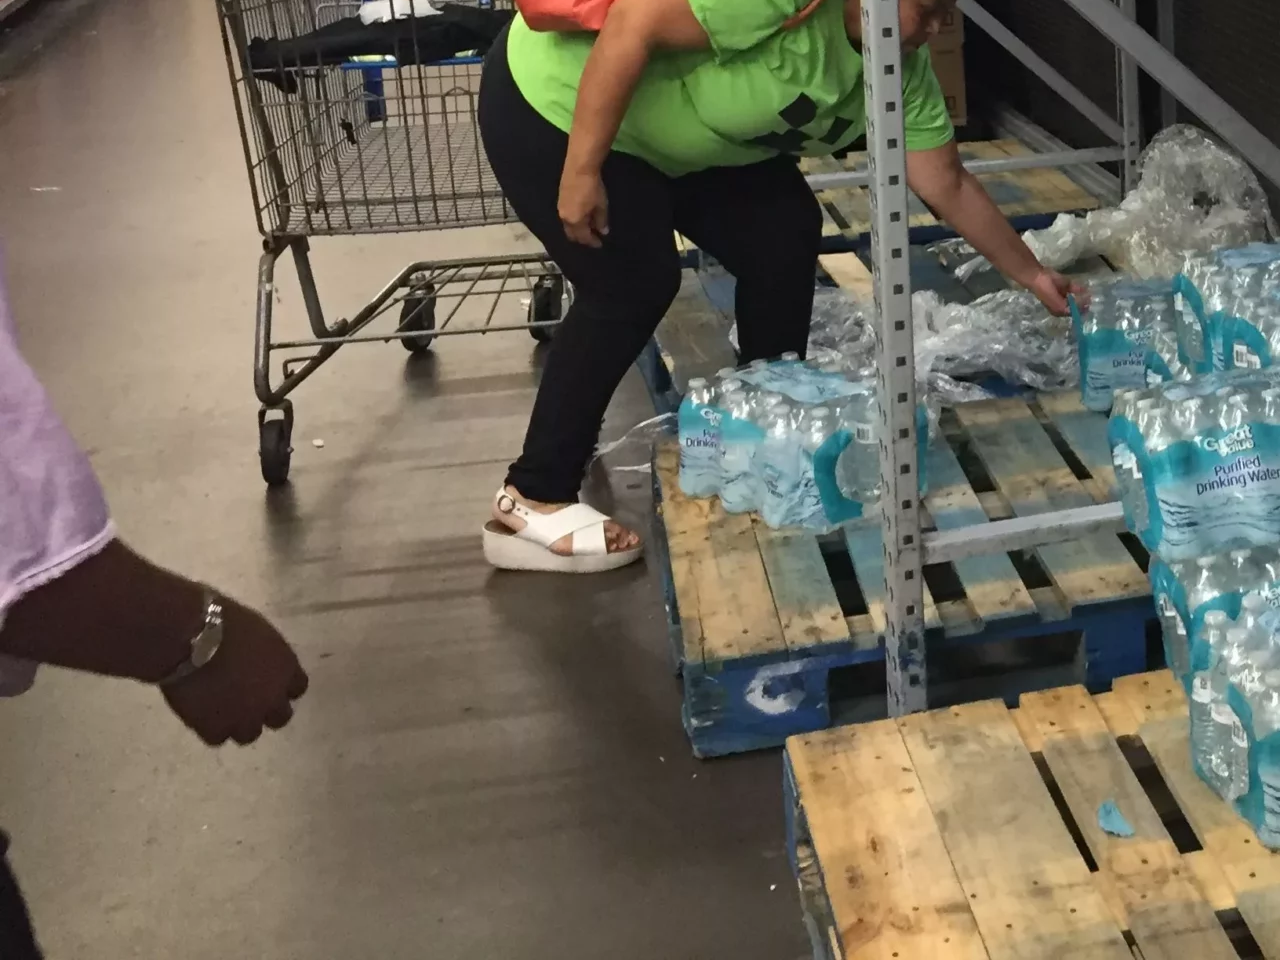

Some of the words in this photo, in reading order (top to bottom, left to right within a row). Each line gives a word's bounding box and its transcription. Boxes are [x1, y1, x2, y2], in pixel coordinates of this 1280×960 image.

[1214, 455, 1261, 477] Purified
[1196, 472, 1248, 495] Drinking
[1247, 467, 1280, 484] Water
